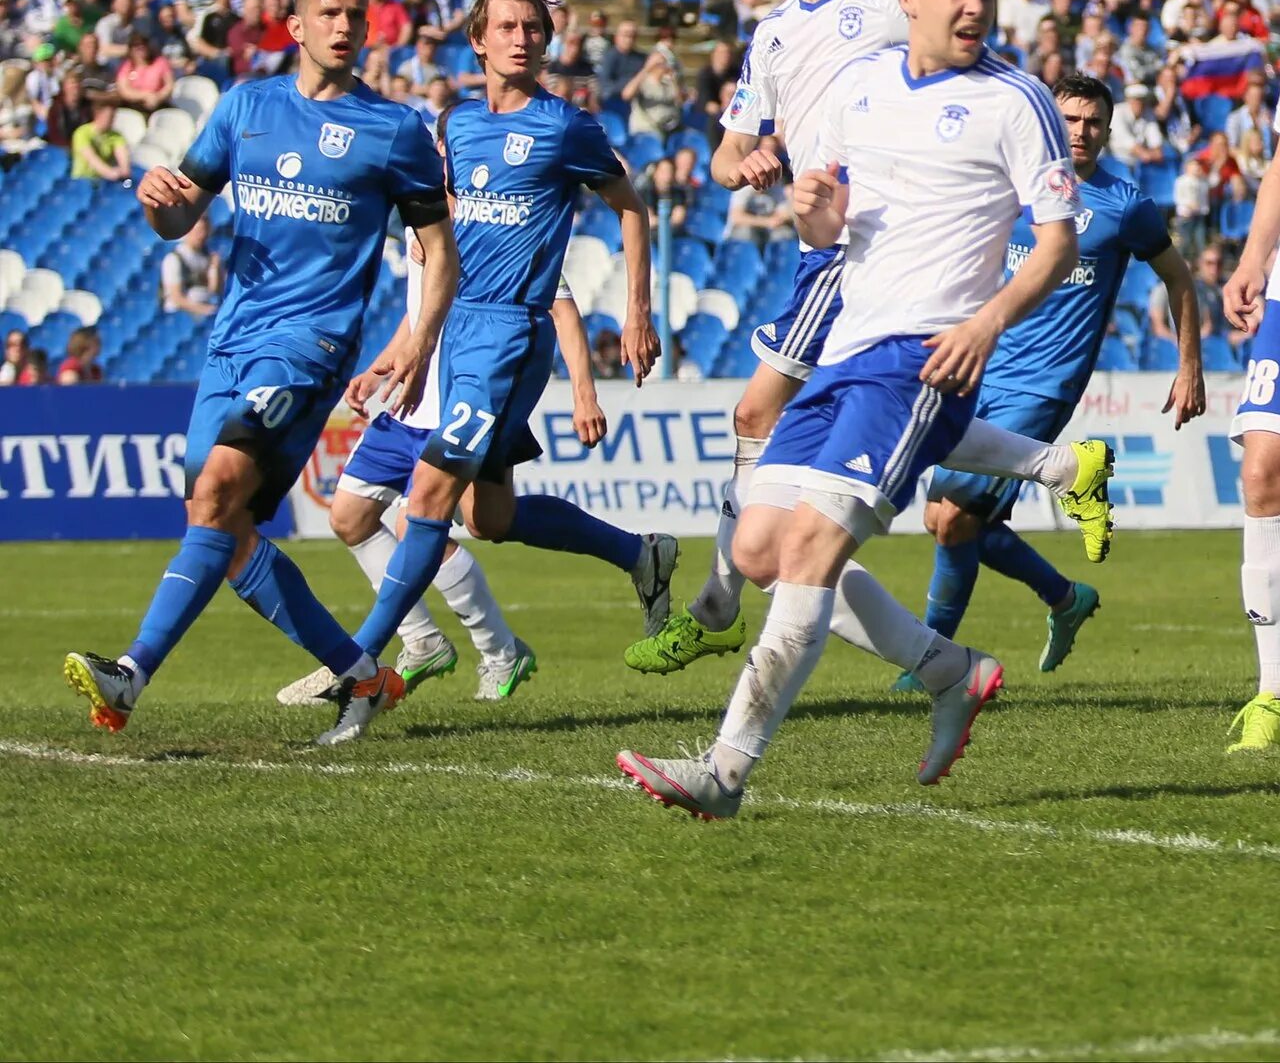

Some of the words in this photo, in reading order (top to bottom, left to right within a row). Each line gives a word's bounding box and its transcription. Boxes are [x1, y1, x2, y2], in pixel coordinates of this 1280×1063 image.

[245, 385, 294, 429] 40
[442, 401, 496, 453] 27
[533, 411, 736, 463] ВИТЕ
[0, 434, 187, 499] ТИК
[522, 479, 735, 517] НИНГРАД
